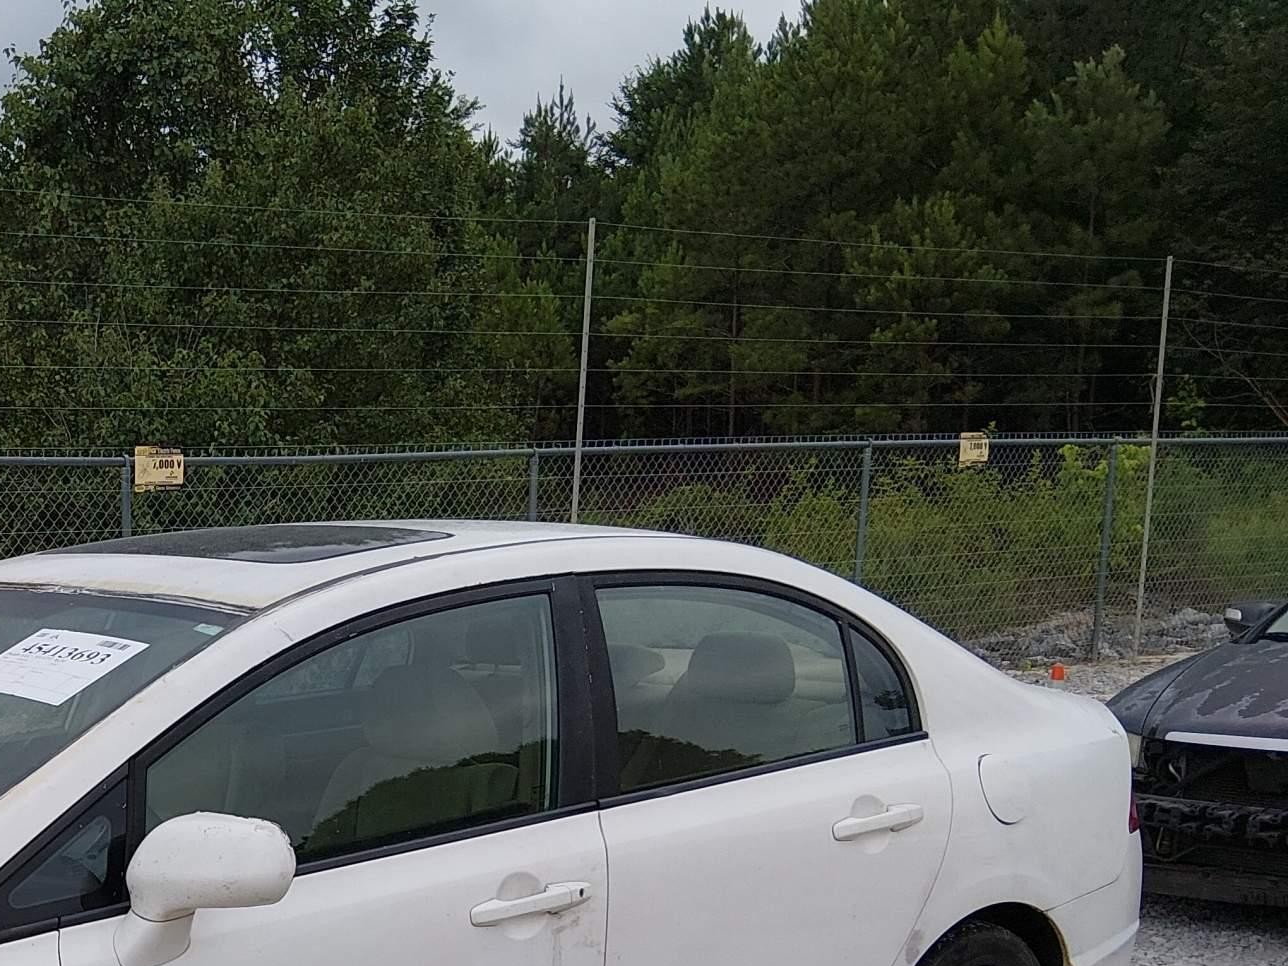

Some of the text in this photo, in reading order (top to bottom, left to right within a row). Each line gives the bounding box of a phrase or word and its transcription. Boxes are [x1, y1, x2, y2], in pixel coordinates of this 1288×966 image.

[152, 459, 182, 470] 7,000 V
[22, 642, 112, 665] 45413693
